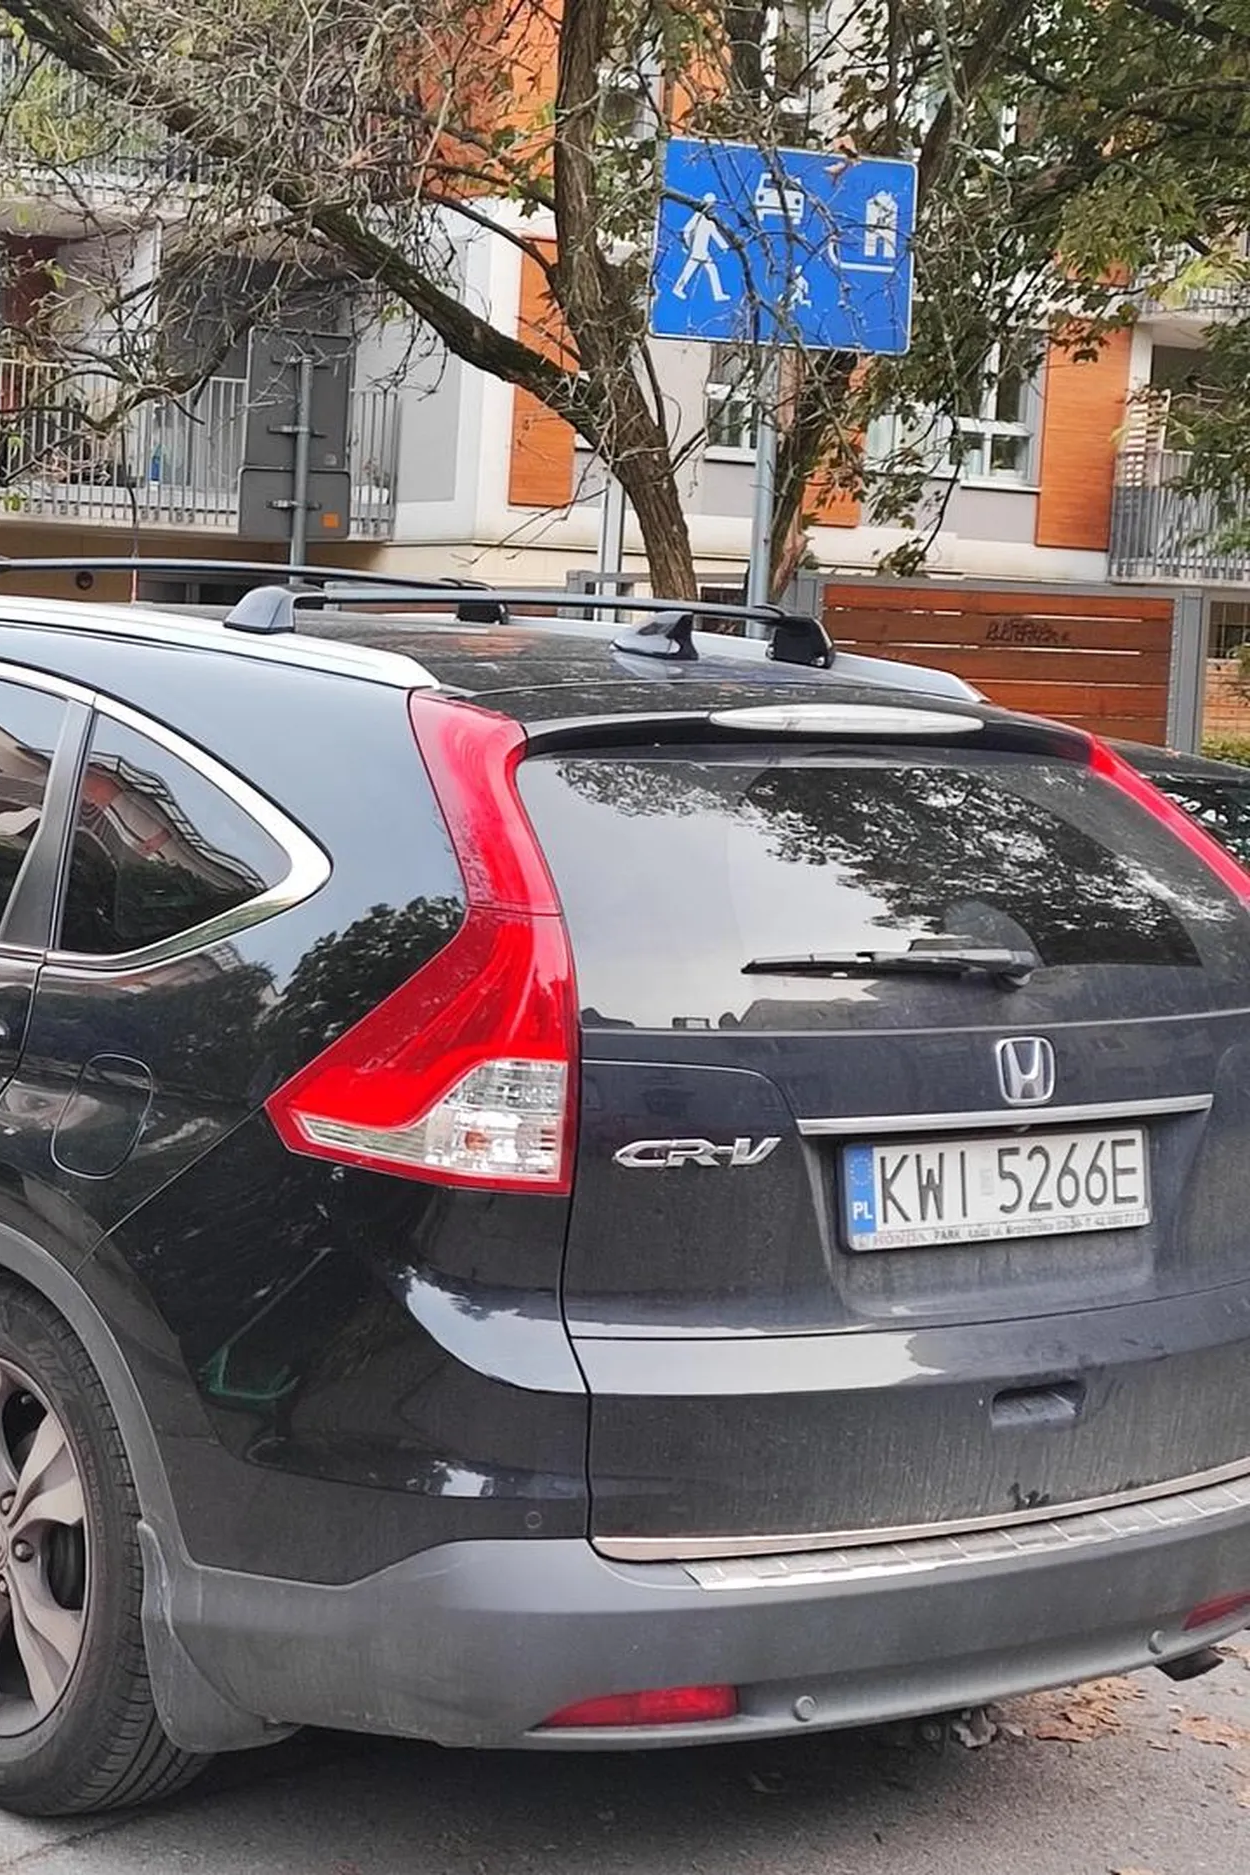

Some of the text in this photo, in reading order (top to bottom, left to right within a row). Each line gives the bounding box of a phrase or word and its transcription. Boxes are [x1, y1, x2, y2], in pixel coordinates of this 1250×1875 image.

[612, 1137, 782, 1168] CR-V
[880, 1138, 1139, 1224] KWI 5266E
[852, 1200, 874, 1221] PL
